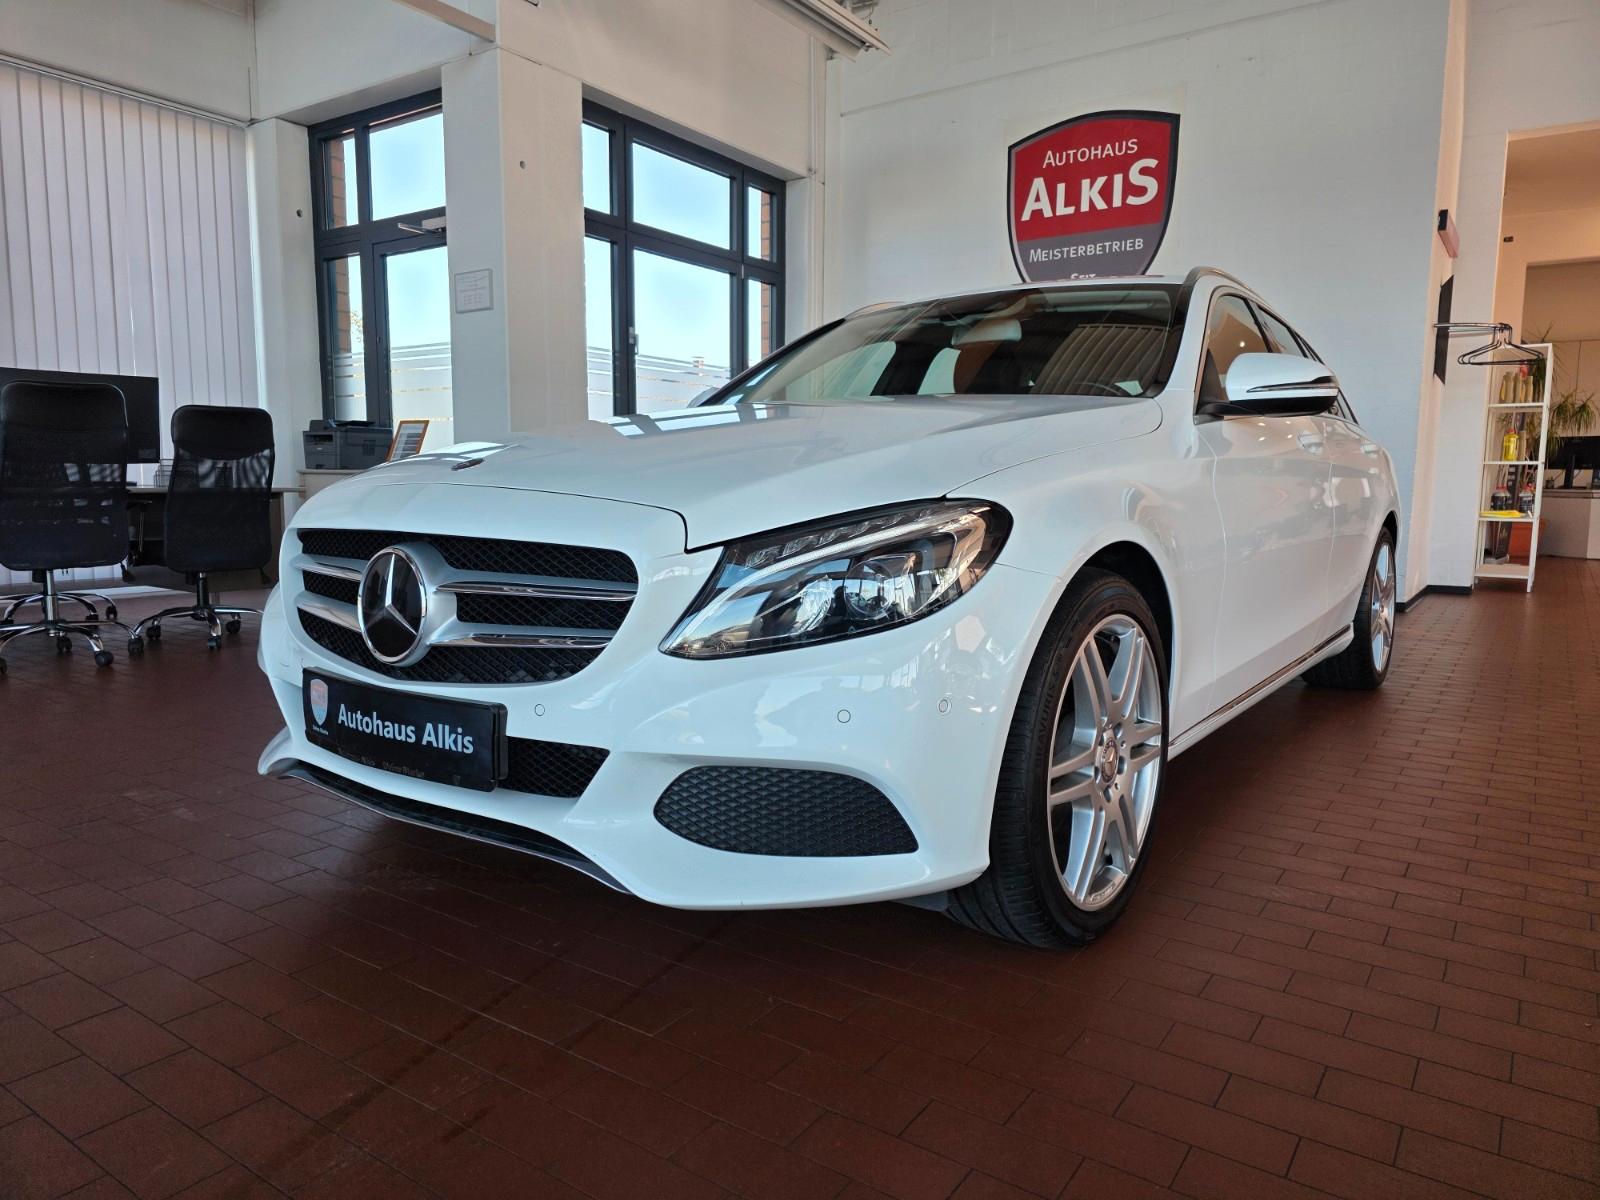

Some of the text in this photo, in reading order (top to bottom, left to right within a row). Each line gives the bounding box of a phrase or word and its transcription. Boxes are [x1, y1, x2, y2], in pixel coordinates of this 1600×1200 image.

[1042, 138, 1138, 169] AUTOHAUS
[1020, 158, 1159, 222] ALKIS
[1029, 238, 1144, 264] MEISTERBETRIEB
[337, 703, 474, 754] Autohaus Alkis
